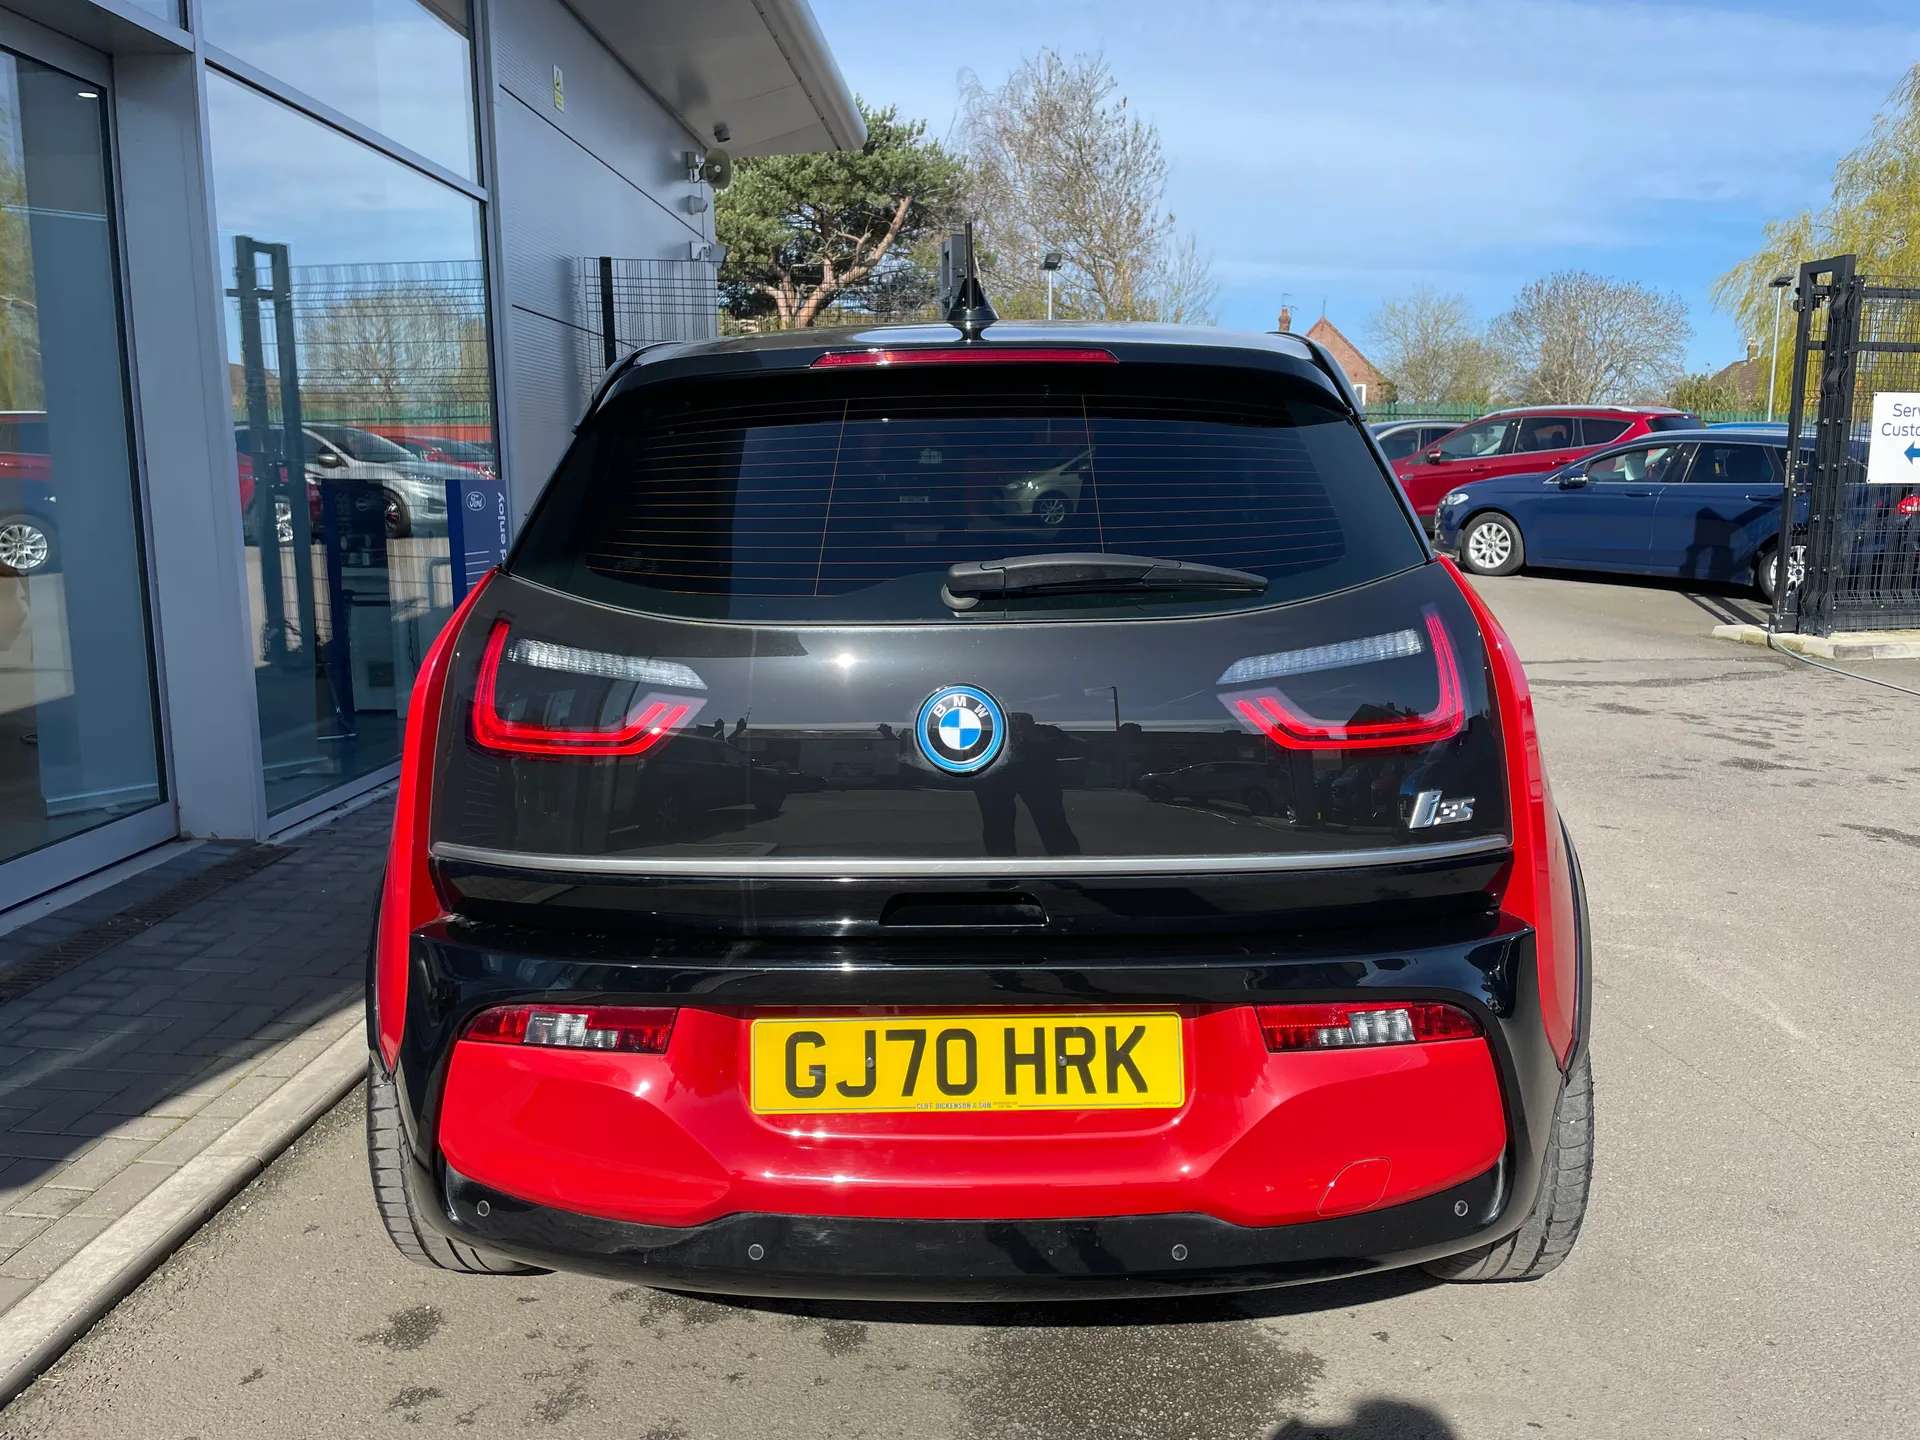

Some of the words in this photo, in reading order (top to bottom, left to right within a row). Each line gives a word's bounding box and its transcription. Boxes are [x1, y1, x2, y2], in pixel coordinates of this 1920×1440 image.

[1892, 403, 1920, 417] Ser
[497, 492, 506, 545] enjoy
[933, 696, 989, 718] BMW
[784, 1028, 978, 1099] GJ70
[1004, 1025, 1149, 1095] HRK
